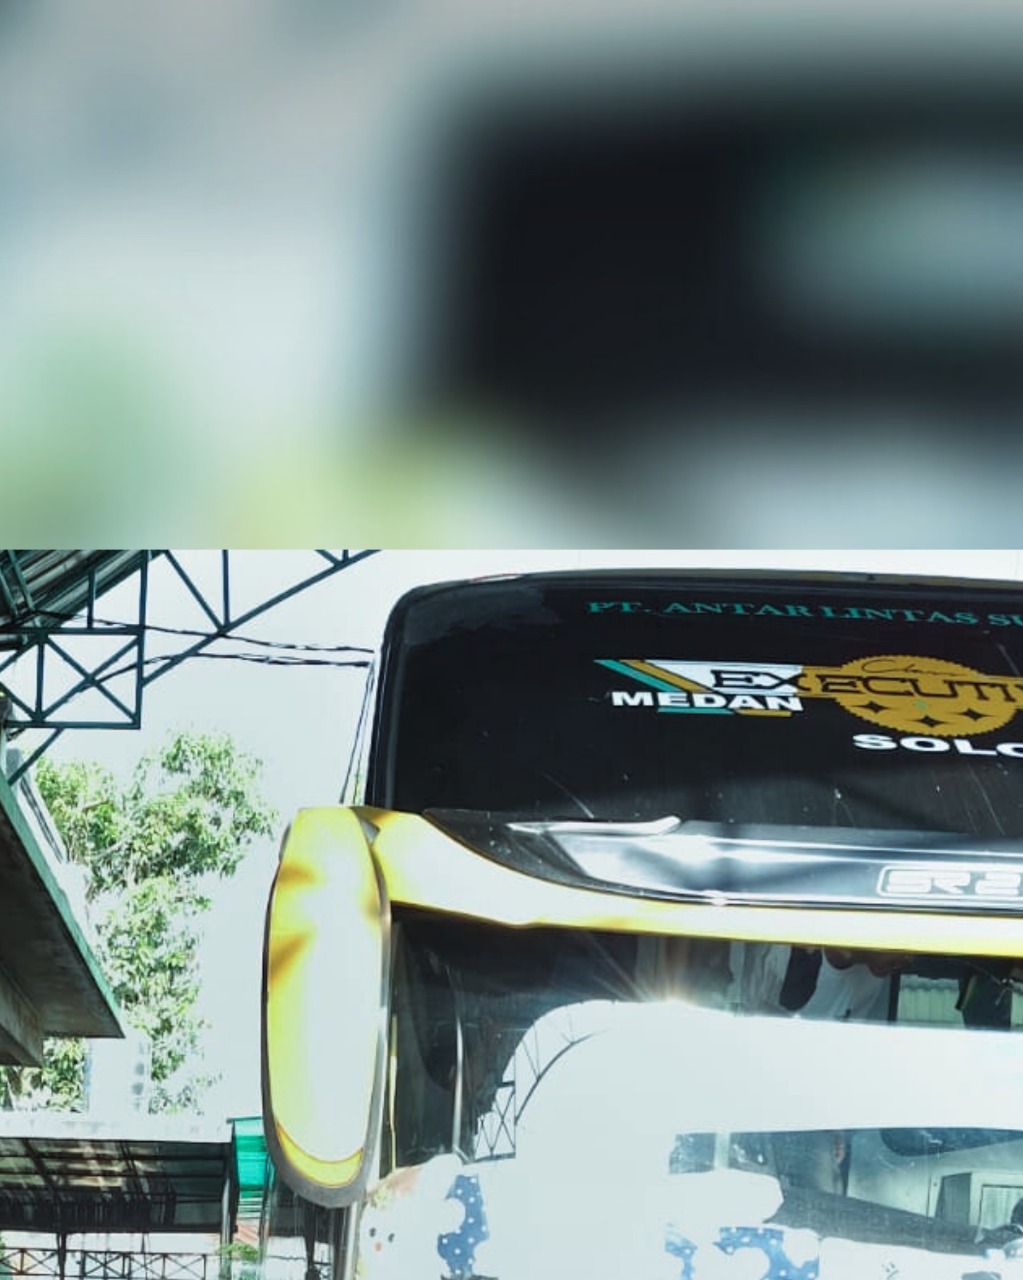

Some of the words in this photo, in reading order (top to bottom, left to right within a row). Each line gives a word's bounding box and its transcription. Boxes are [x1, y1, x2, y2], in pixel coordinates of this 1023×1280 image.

[587, 601, 652, 614] PT.
[663, 602, 814, 617] ANTAR
[819, 605, 979, 624] LINTAS
[710, 669, 1023, 703] EXECUTI
[611, 691, 804, 711] MEDAN
